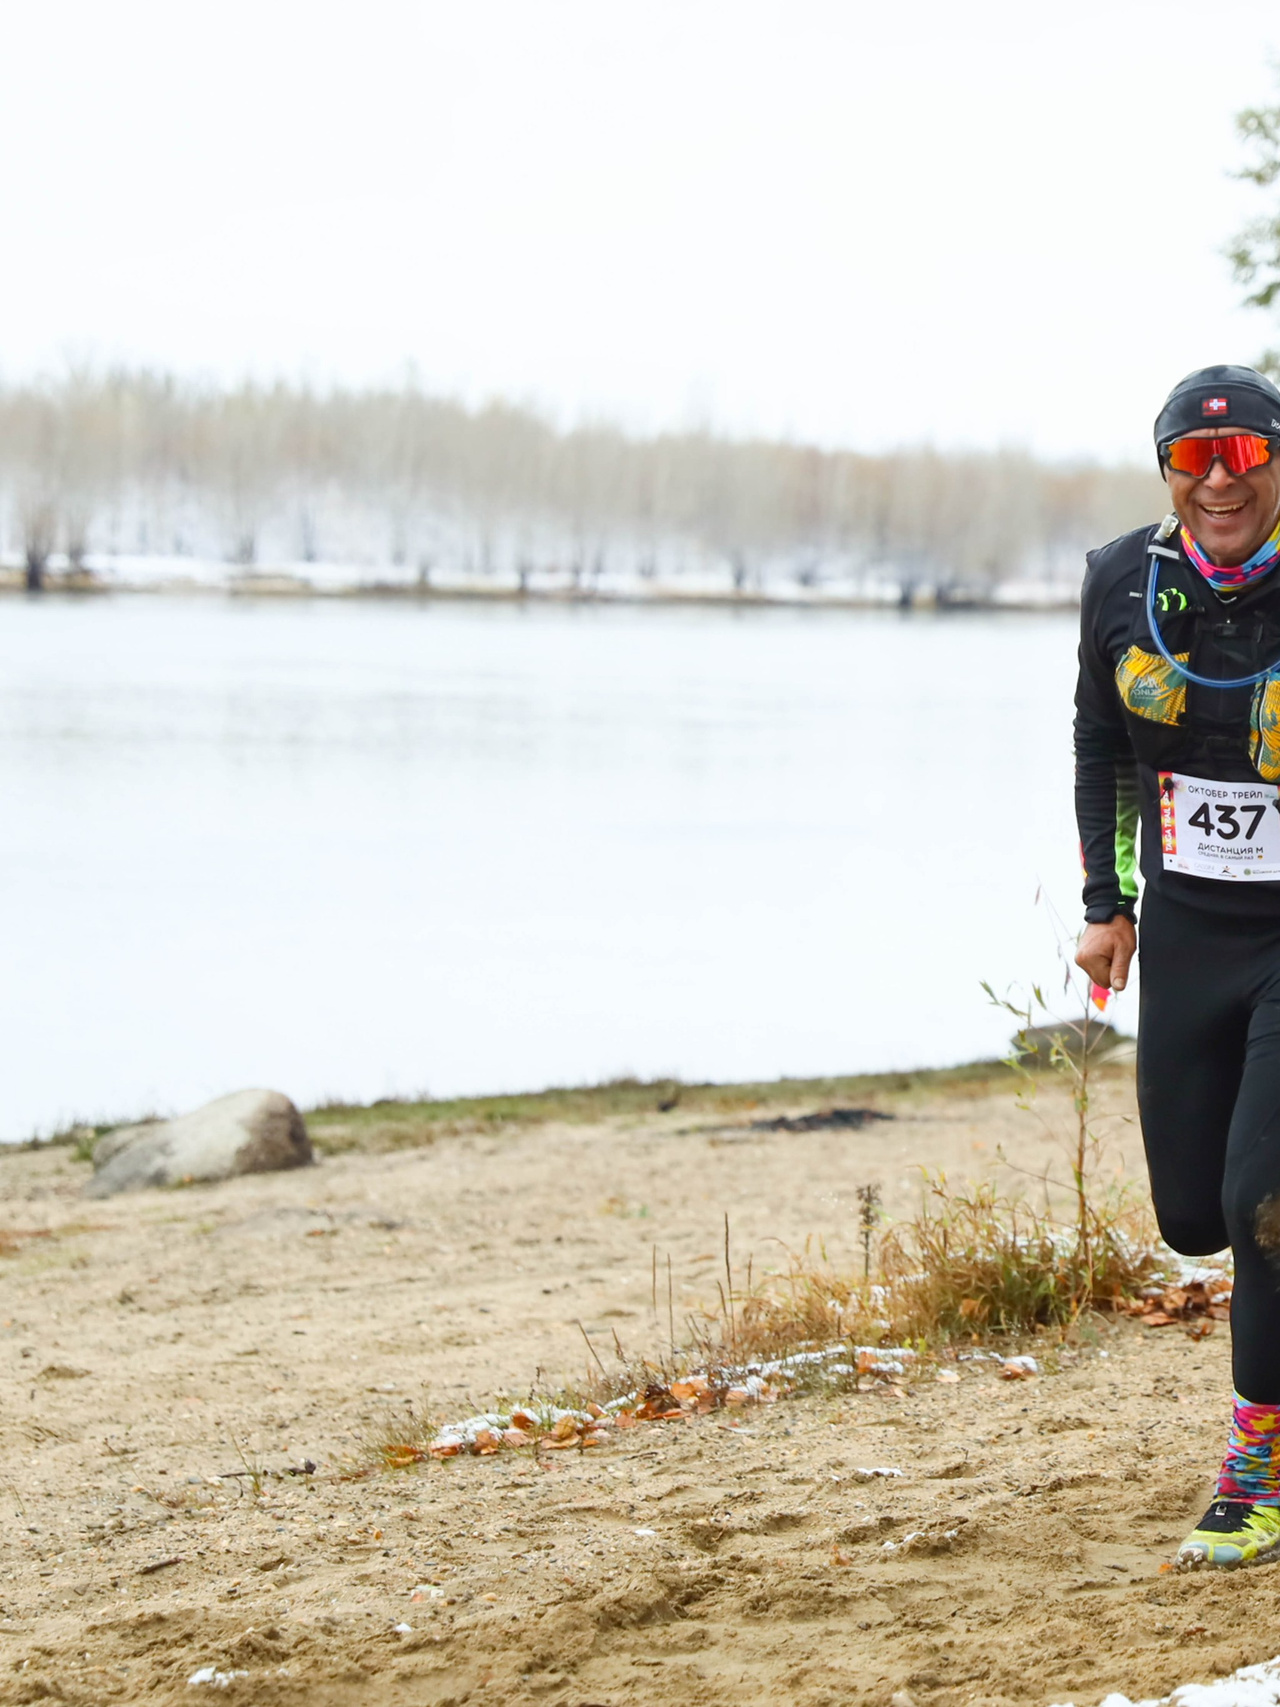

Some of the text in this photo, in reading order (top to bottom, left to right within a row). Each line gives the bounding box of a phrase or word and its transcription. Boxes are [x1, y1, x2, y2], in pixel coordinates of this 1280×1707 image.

[1187, 785, 1228, 798] ОКТОБЕР
[1231, 790, 1263, 799] ТРЕЙЛ
[1163, 807, 1172, 828] TRAIL
[1188, 802, 1266, 840] 437
[1164, 828, 1173, 852] TAIGA
[1197, 842, 1253, 855] ДИСТАНЦИЯ
